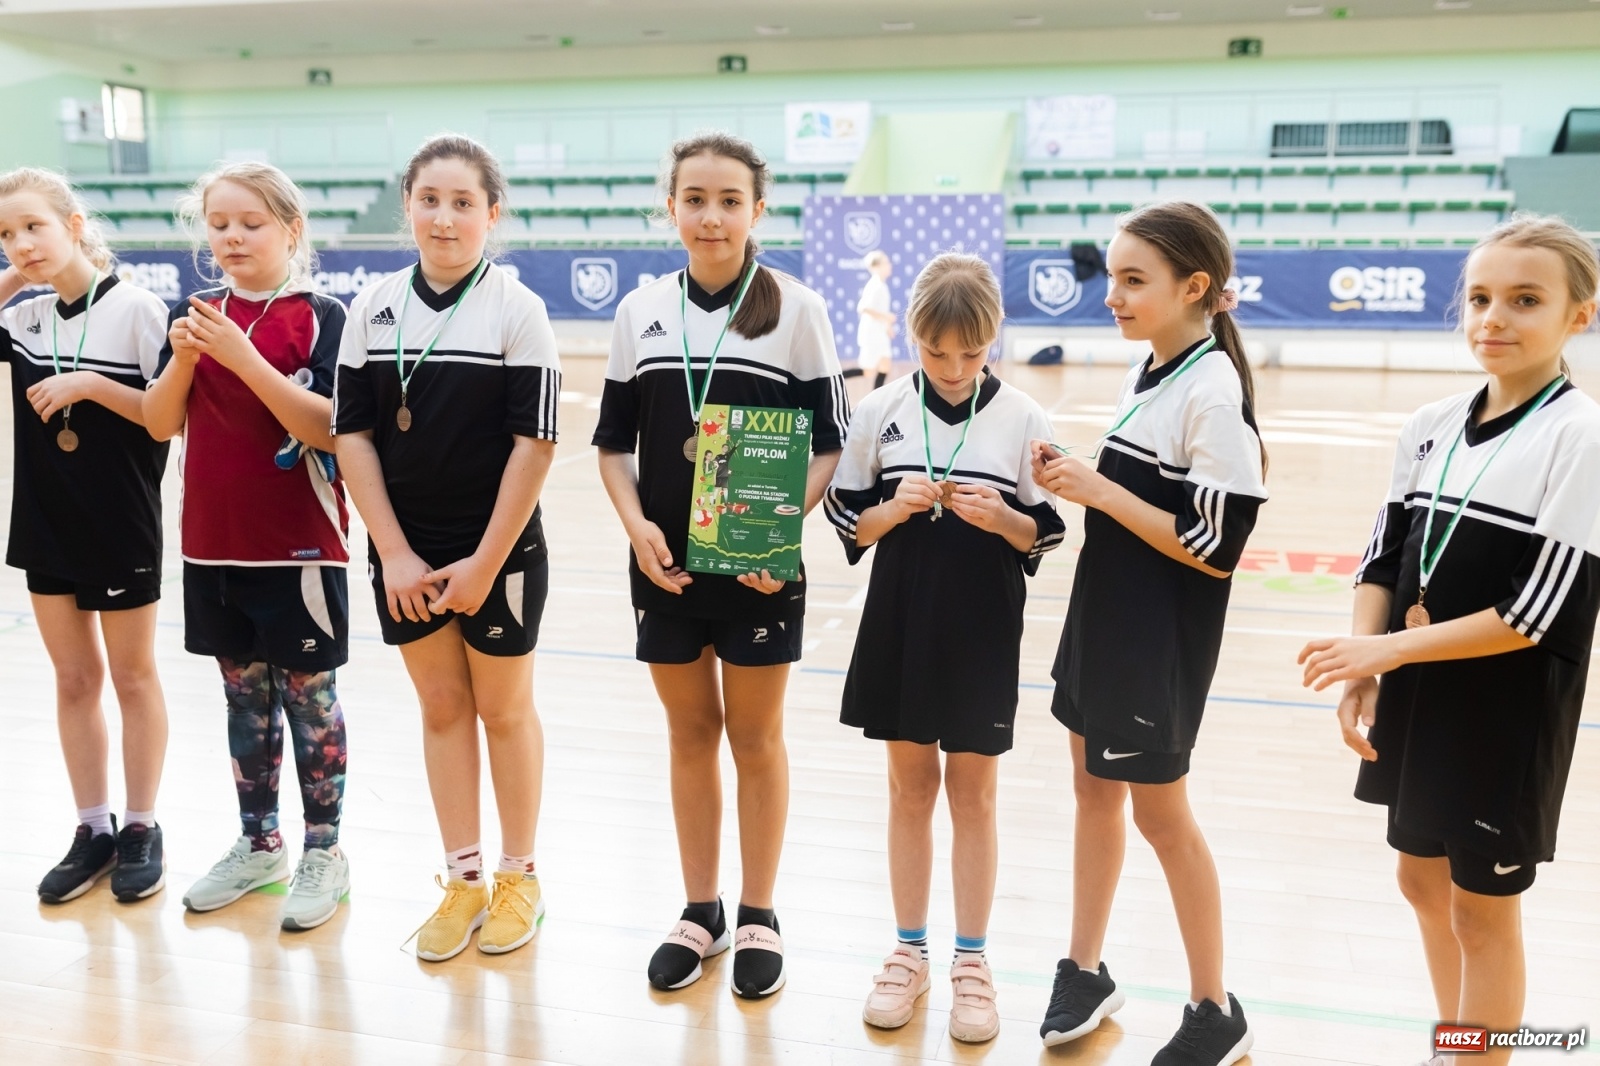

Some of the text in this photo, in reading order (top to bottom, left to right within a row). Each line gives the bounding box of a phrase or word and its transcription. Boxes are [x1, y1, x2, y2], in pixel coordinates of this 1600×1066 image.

[1329, 266, 1426, 301] OSiR
[371, 317, 396, 326] adidas
[640, 330, 666, 339] adidas
[744, 410, 792, 433] XXII
[744, 447, 787, 459] DYPLOM
[684, 934, 703, 947] BUNNY
[756, 937, 776, 945] BUNNY
